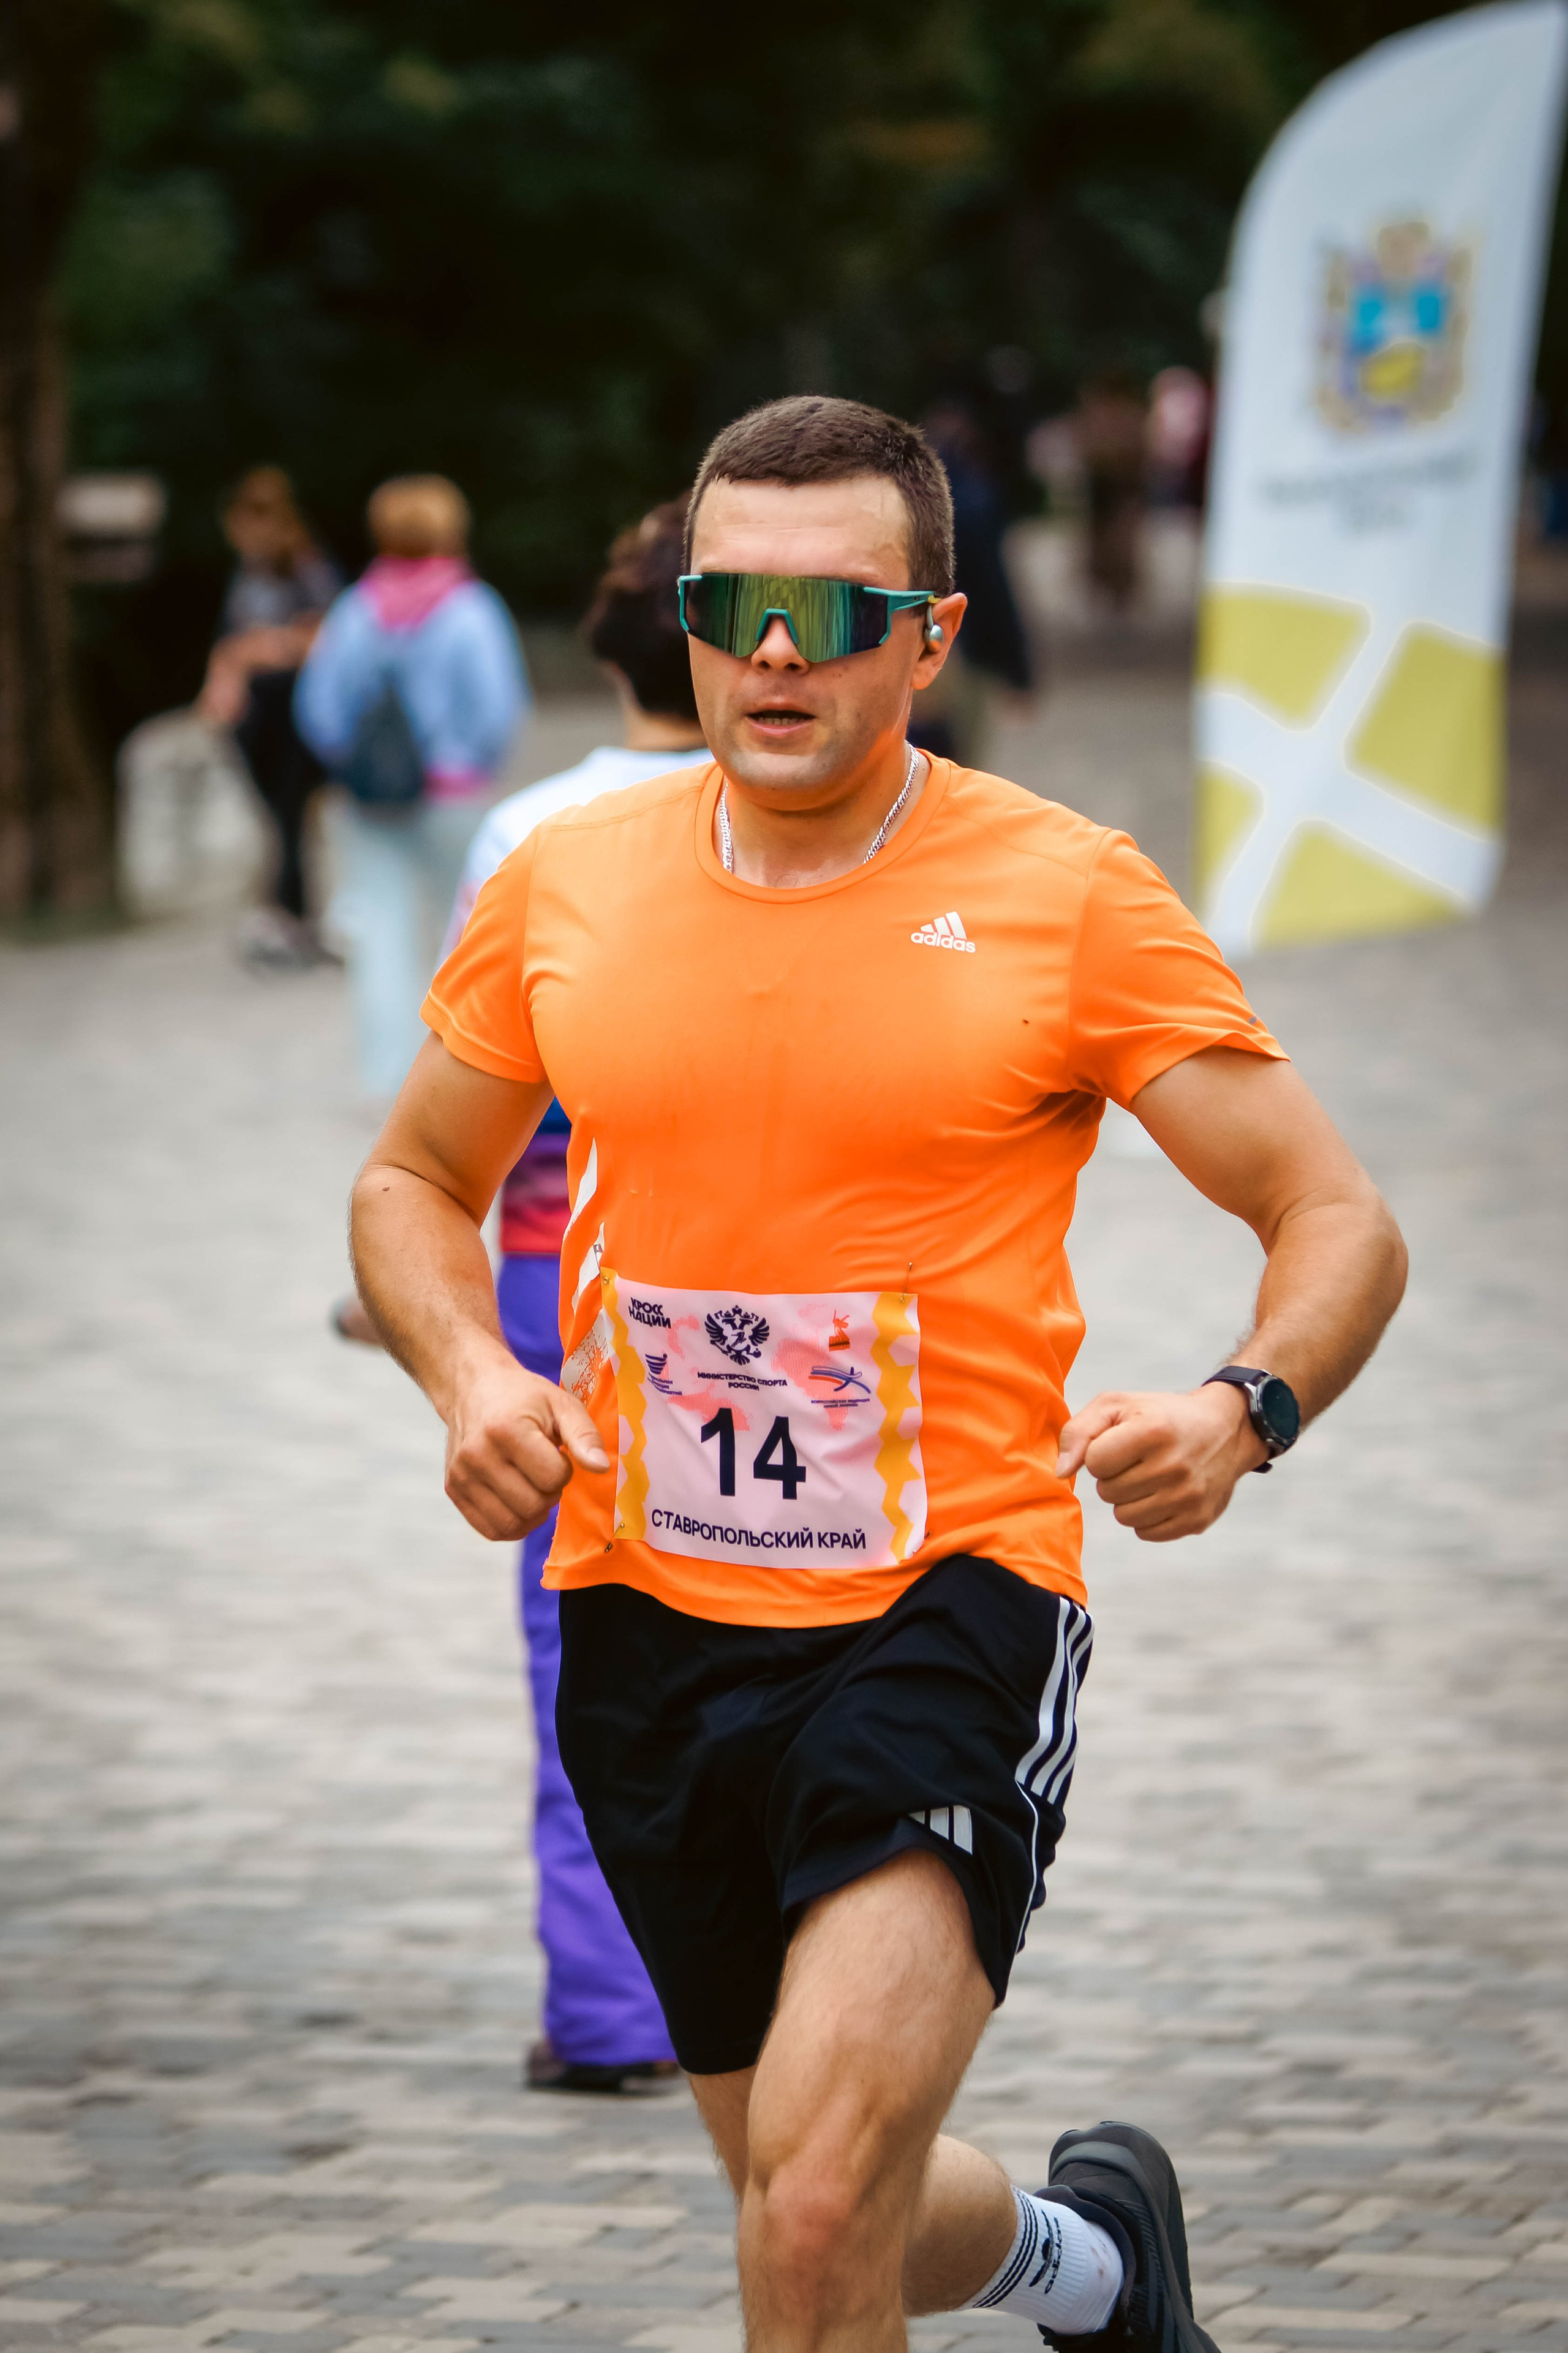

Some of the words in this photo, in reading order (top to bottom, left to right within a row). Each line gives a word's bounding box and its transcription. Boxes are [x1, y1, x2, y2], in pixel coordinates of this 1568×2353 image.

[911, 932, 976, 953] adidas
[628, 1305, 671, 1329] НАЦИИ
[630, 1297, 663, 1316] КРОСС
[697, 1372, 756, 1383] МИНИСТЕРСТВО
[728, 1382, 760, 1391] РОССИИ
[701, 1408, 806, 1500] 14
[651, 1509, 813, 1548] СТАВРОПОЛЬСКИЙ
[818, 1528, 867, 1549] КРАЙ
